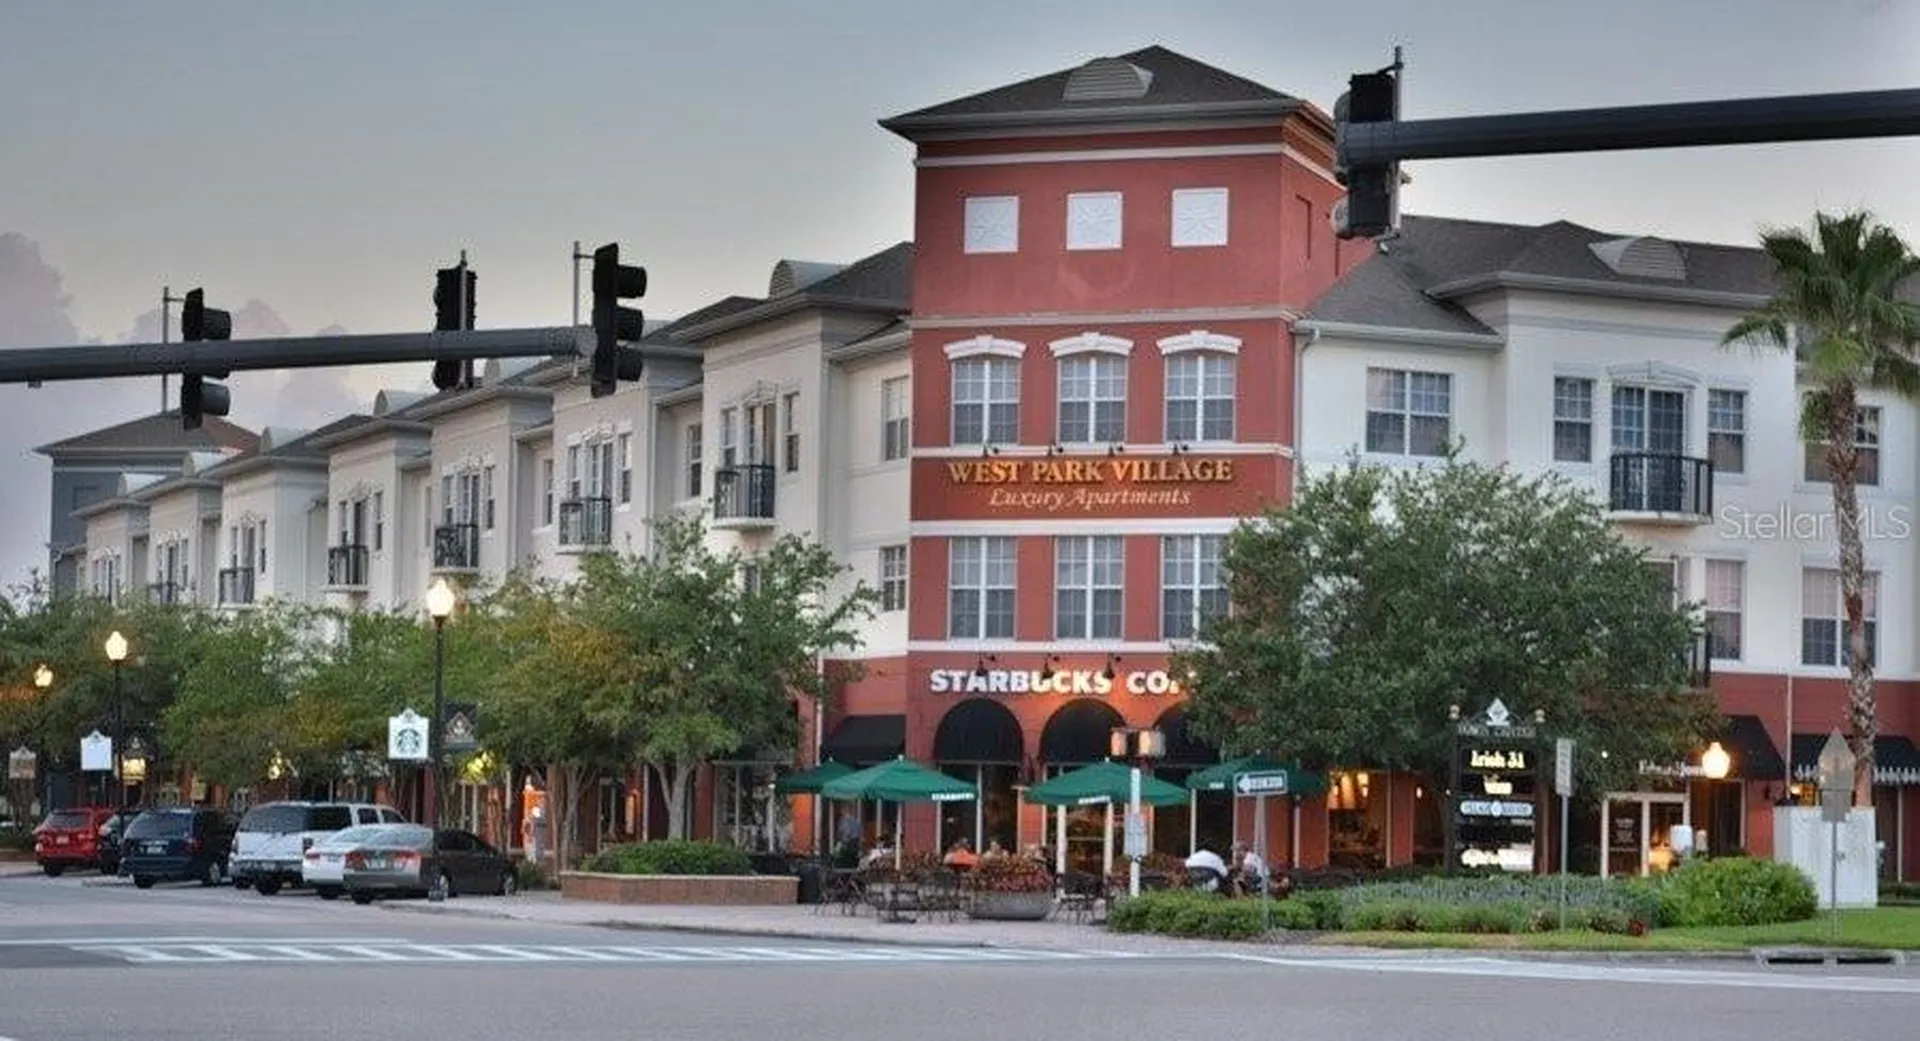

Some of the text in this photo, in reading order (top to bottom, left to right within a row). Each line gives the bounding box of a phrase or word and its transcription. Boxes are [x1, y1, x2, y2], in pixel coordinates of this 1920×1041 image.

[947, 459, 1233, 483] WEST PARK VILLAGE
[989, 487, 1192, 511] Luxury Apartments
[930, 669, 1113, 695] STARBUCKS
